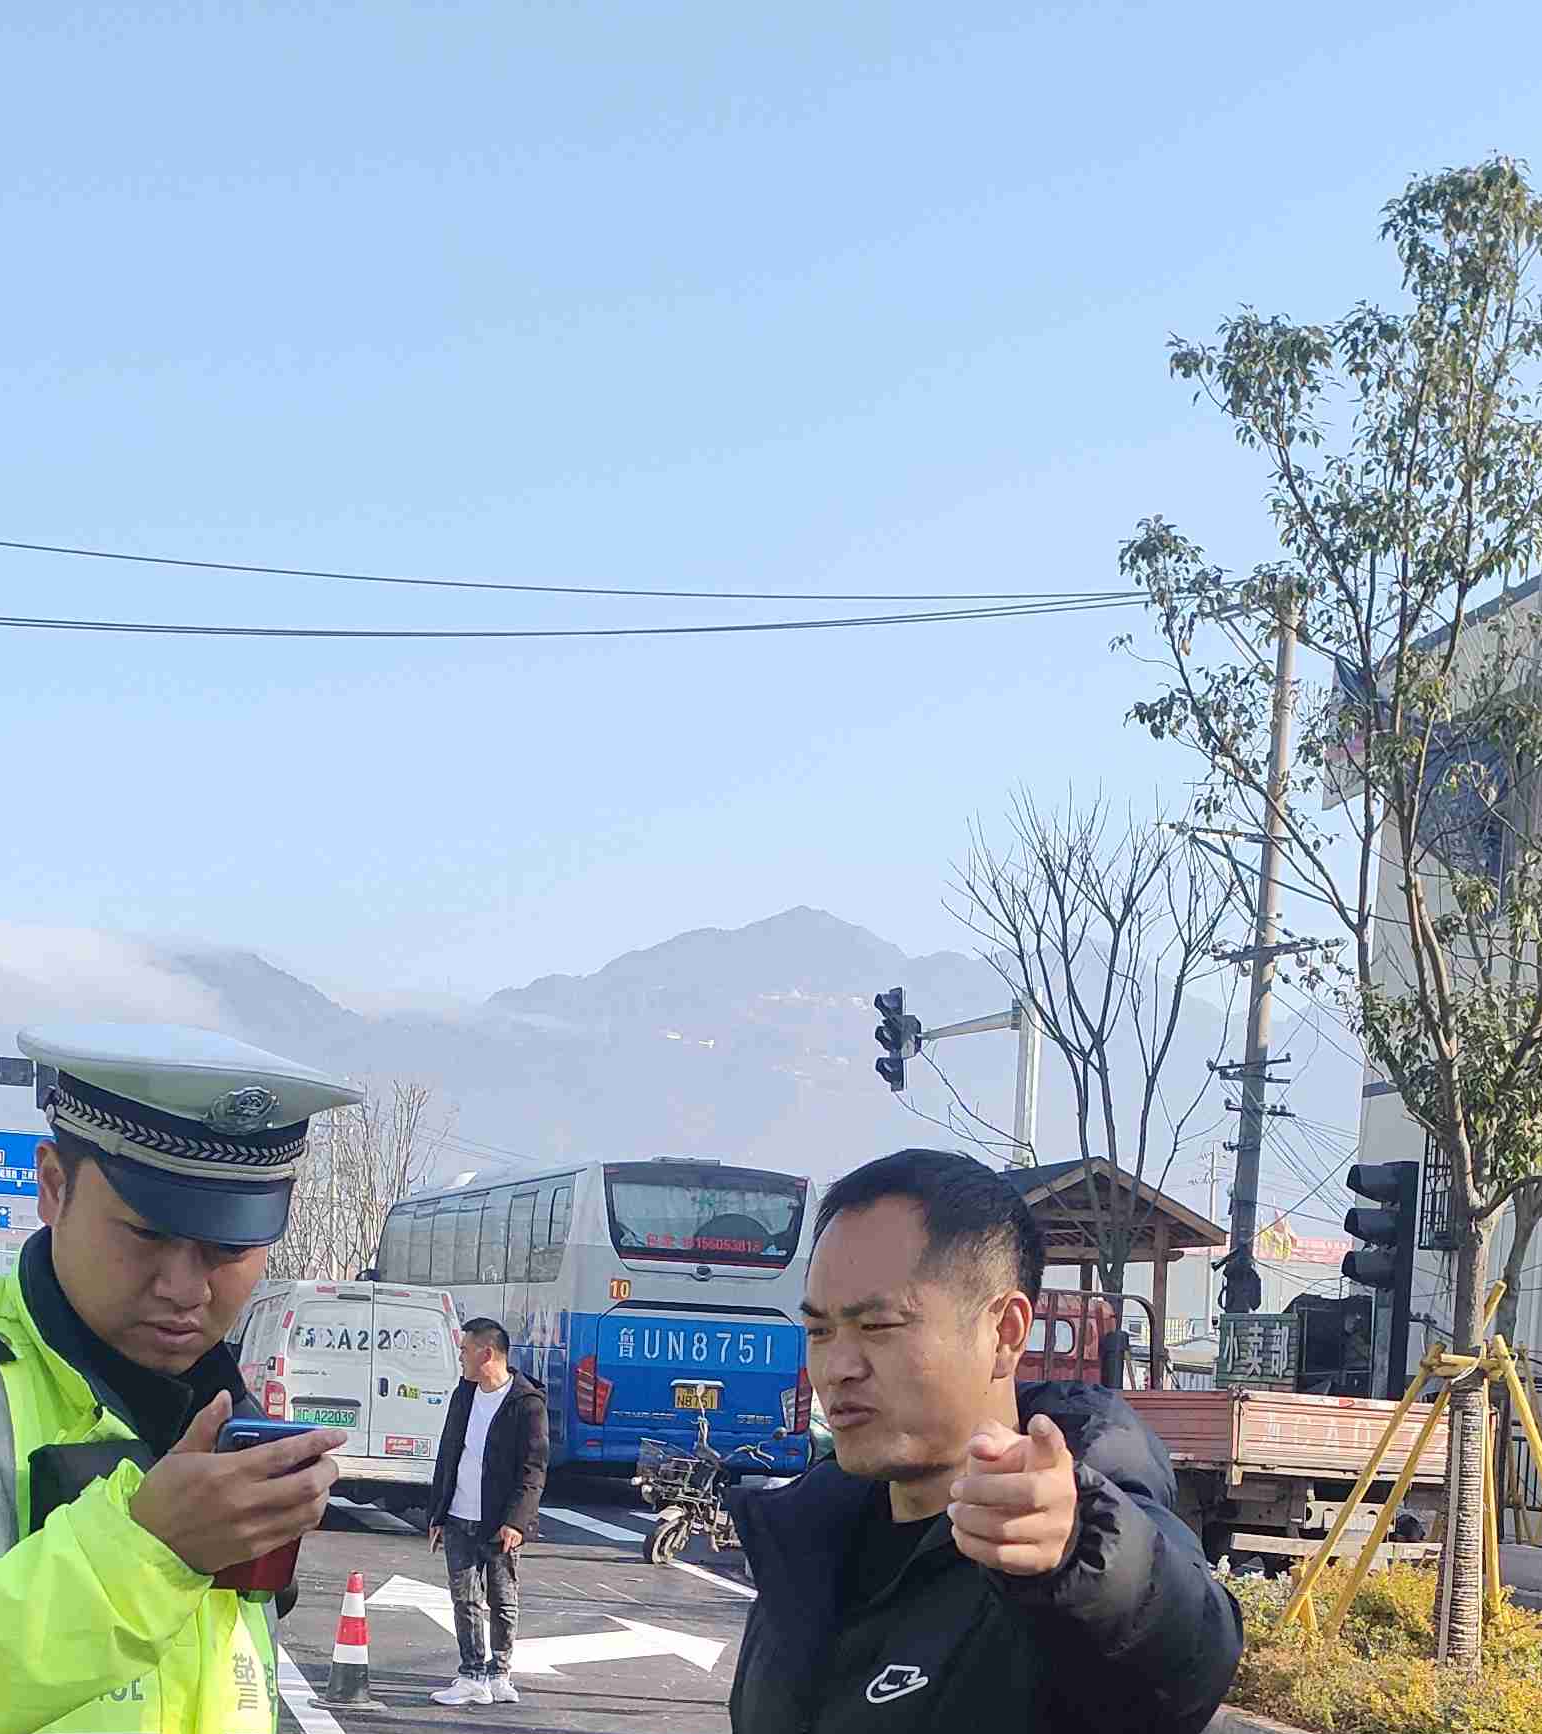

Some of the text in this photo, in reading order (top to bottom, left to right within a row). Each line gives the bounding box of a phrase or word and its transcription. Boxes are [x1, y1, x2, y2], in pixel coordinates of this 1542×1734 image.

[610, 1281, 630, 1298] 10
[617, 1327, 772, 1365] 鲁UN8751
[1222, 1321, 1290, 1380] 小卖部
